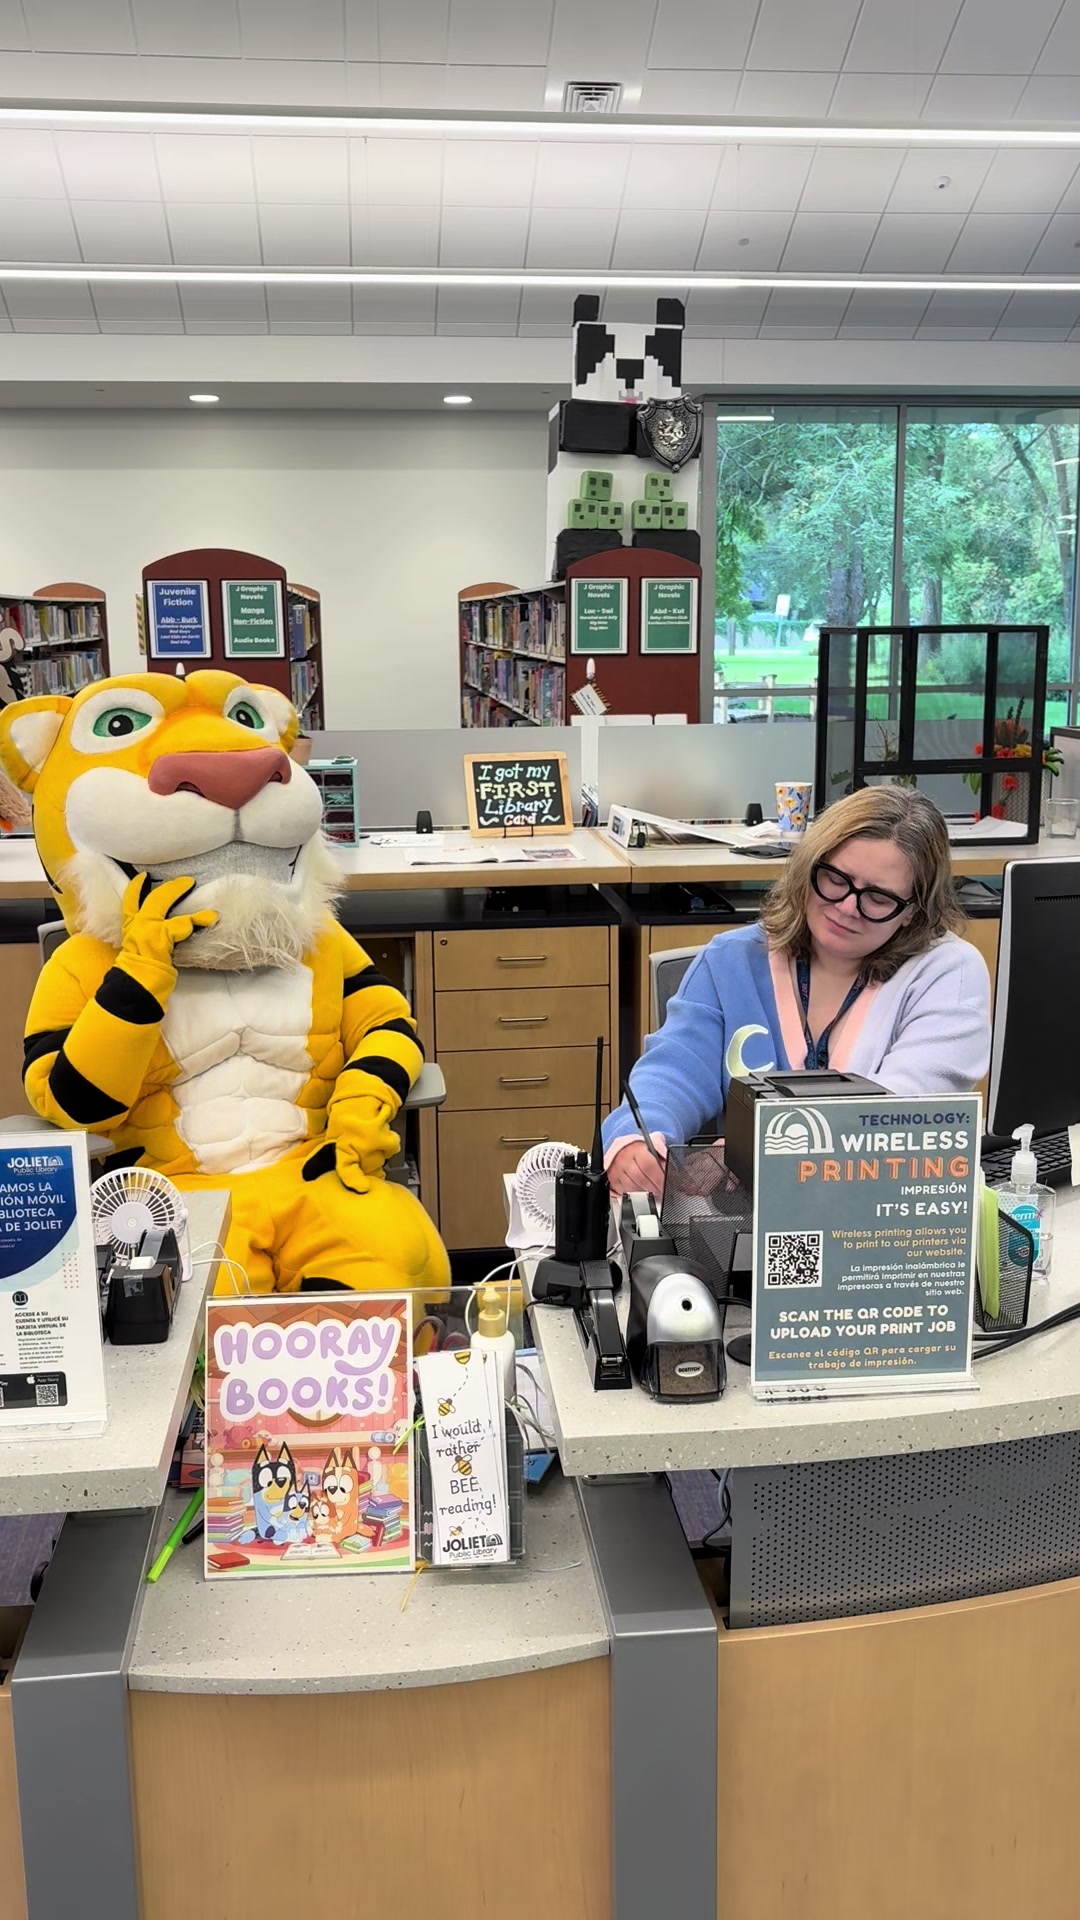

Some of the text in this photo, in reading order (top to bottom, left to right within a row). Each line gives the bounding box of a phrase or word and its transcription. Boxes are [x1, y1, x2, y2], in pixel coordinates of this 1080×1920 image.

[478, 763, 551, 782] I got my
[485, 798, 553, 815] Library
[504, 813, 537, 826] Card
[859, 1113, 970, 1126] TECHNOLOGY:
[840, 1130, 969, 1152] WIRELESS
[7, 1156, 49, 1168] JOLIET
[797, 1156, 969, 1183] PRINTING
[38, 1182, 52, 1191] LA
[901, 1182, 967, 1195] IMPRESIÓN
[28, 1193, 66, 1204] MÓVIL
[876, 1201, 968, 1217] IT'S EASY!
[6, 1220, 62, 1232] DE JOLIET
[832, 1227, 967, 1238] Wireless printing allows you
[856, 1240, 878, 1250] print
[912, 1238, 948, 1248] printers
[926, 1248, 966, 1256] website.
[863, 1263, 903, 1272] impresión
[905, 1262, 955, 1270] inalámbrica
[842, 1273, 879, 1282] permitirá
[882, 1272, 915, 1281] imprimir
[779, 1305, 948, 1322] SCAN THE QR CODE TO
[770, 1320, 956, 1339] UPLOAD YOUR PRINT JOB
[220, 1323, 396, 1376] HOORAY
[768, 1351, 811, 1360] Escanee
[827, 1348, 860, 1359] código
[864, 1347, 878, 1355] QR
[882, 1347, 905, 1356] para
[908, 1345, 941, 1355] cargar
[808, 1356, 916, 1370] trabajo de impresión.
[226, 1373, 389, 1415] BOOKS!
[432, 1419, 482, 1439] I would
[436, 1440, 482, 1458] rather
[450, 1476, 479, 1495] BEE
[439, 1494, 497, 1516] reading!
[442, 1535, 487, 1552] JOLIET
[473, 1548, 497, 1556] Library
